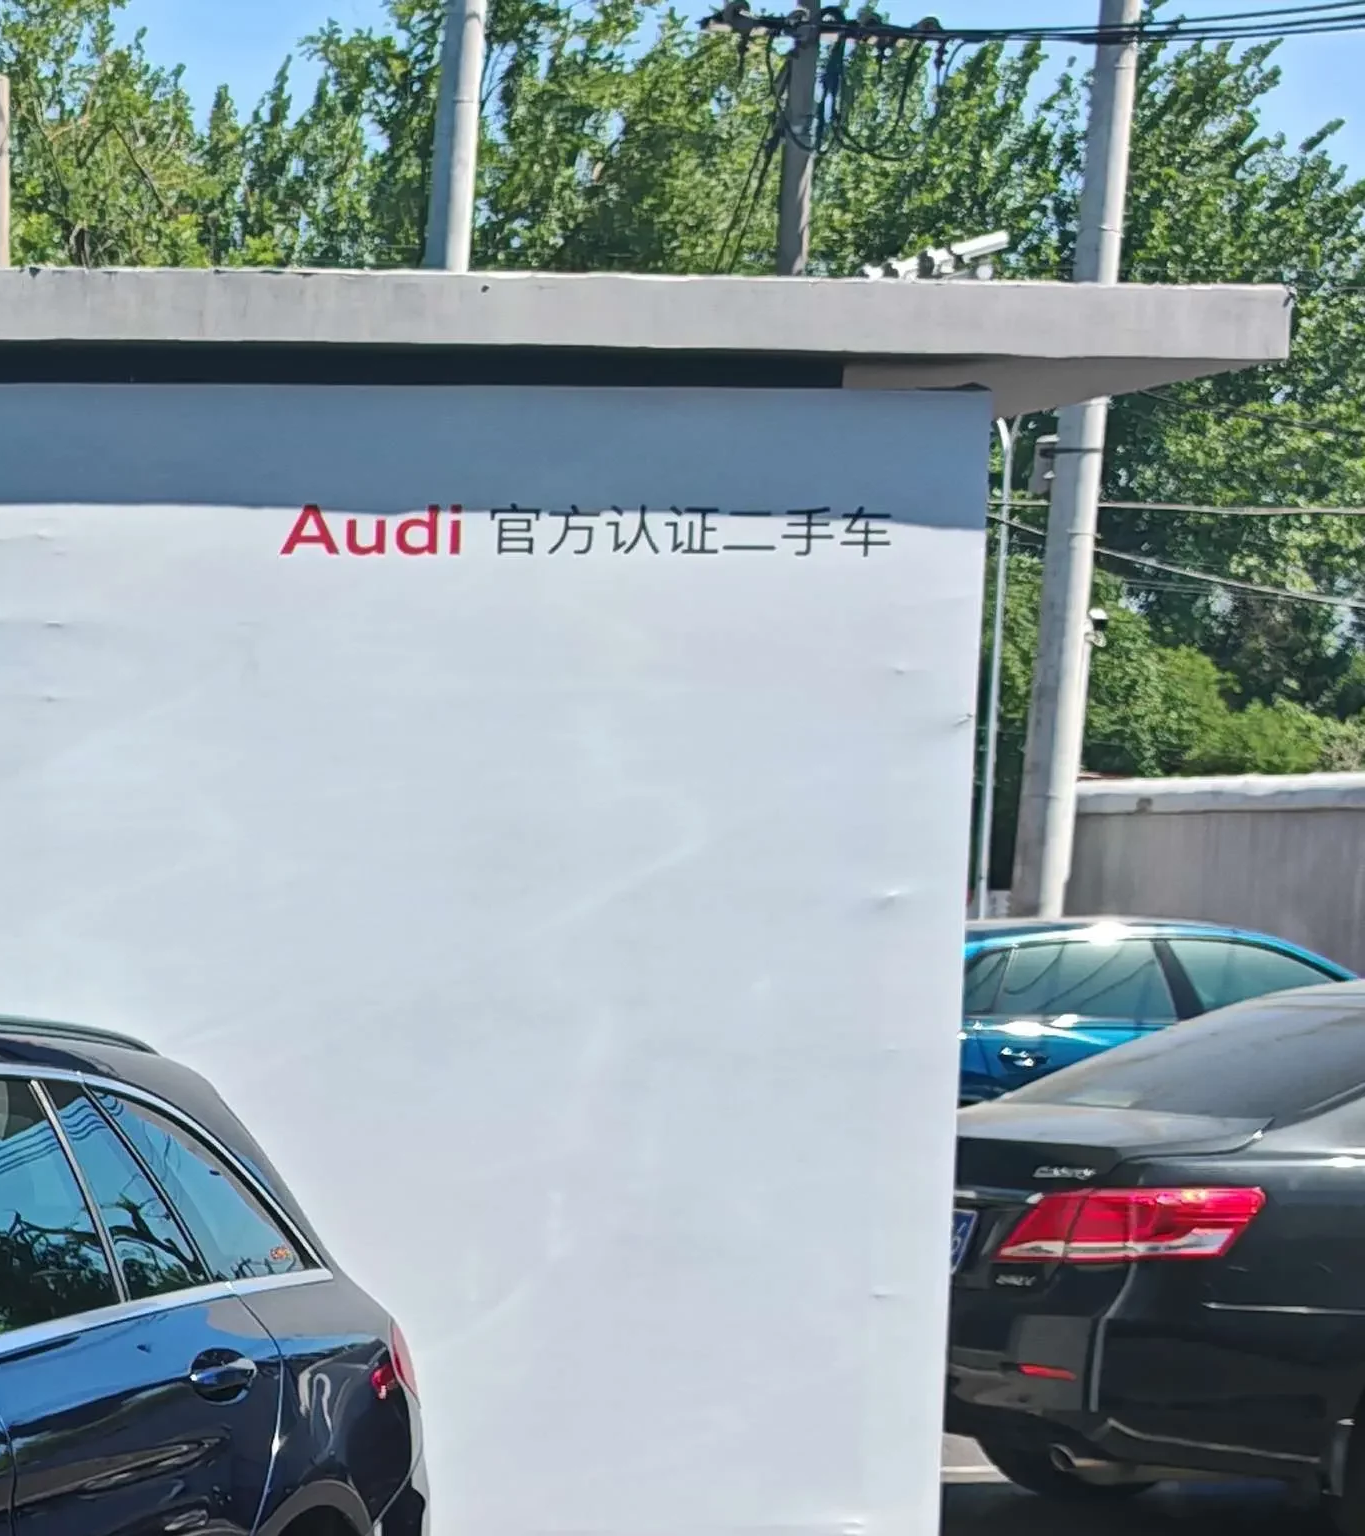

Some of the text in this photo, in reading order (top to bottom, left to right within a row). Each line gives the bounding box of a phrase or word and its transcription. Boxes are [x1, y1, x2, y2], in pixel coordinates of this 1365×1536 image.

[279, 504, 893, 558] Audi 官方认证二手车
